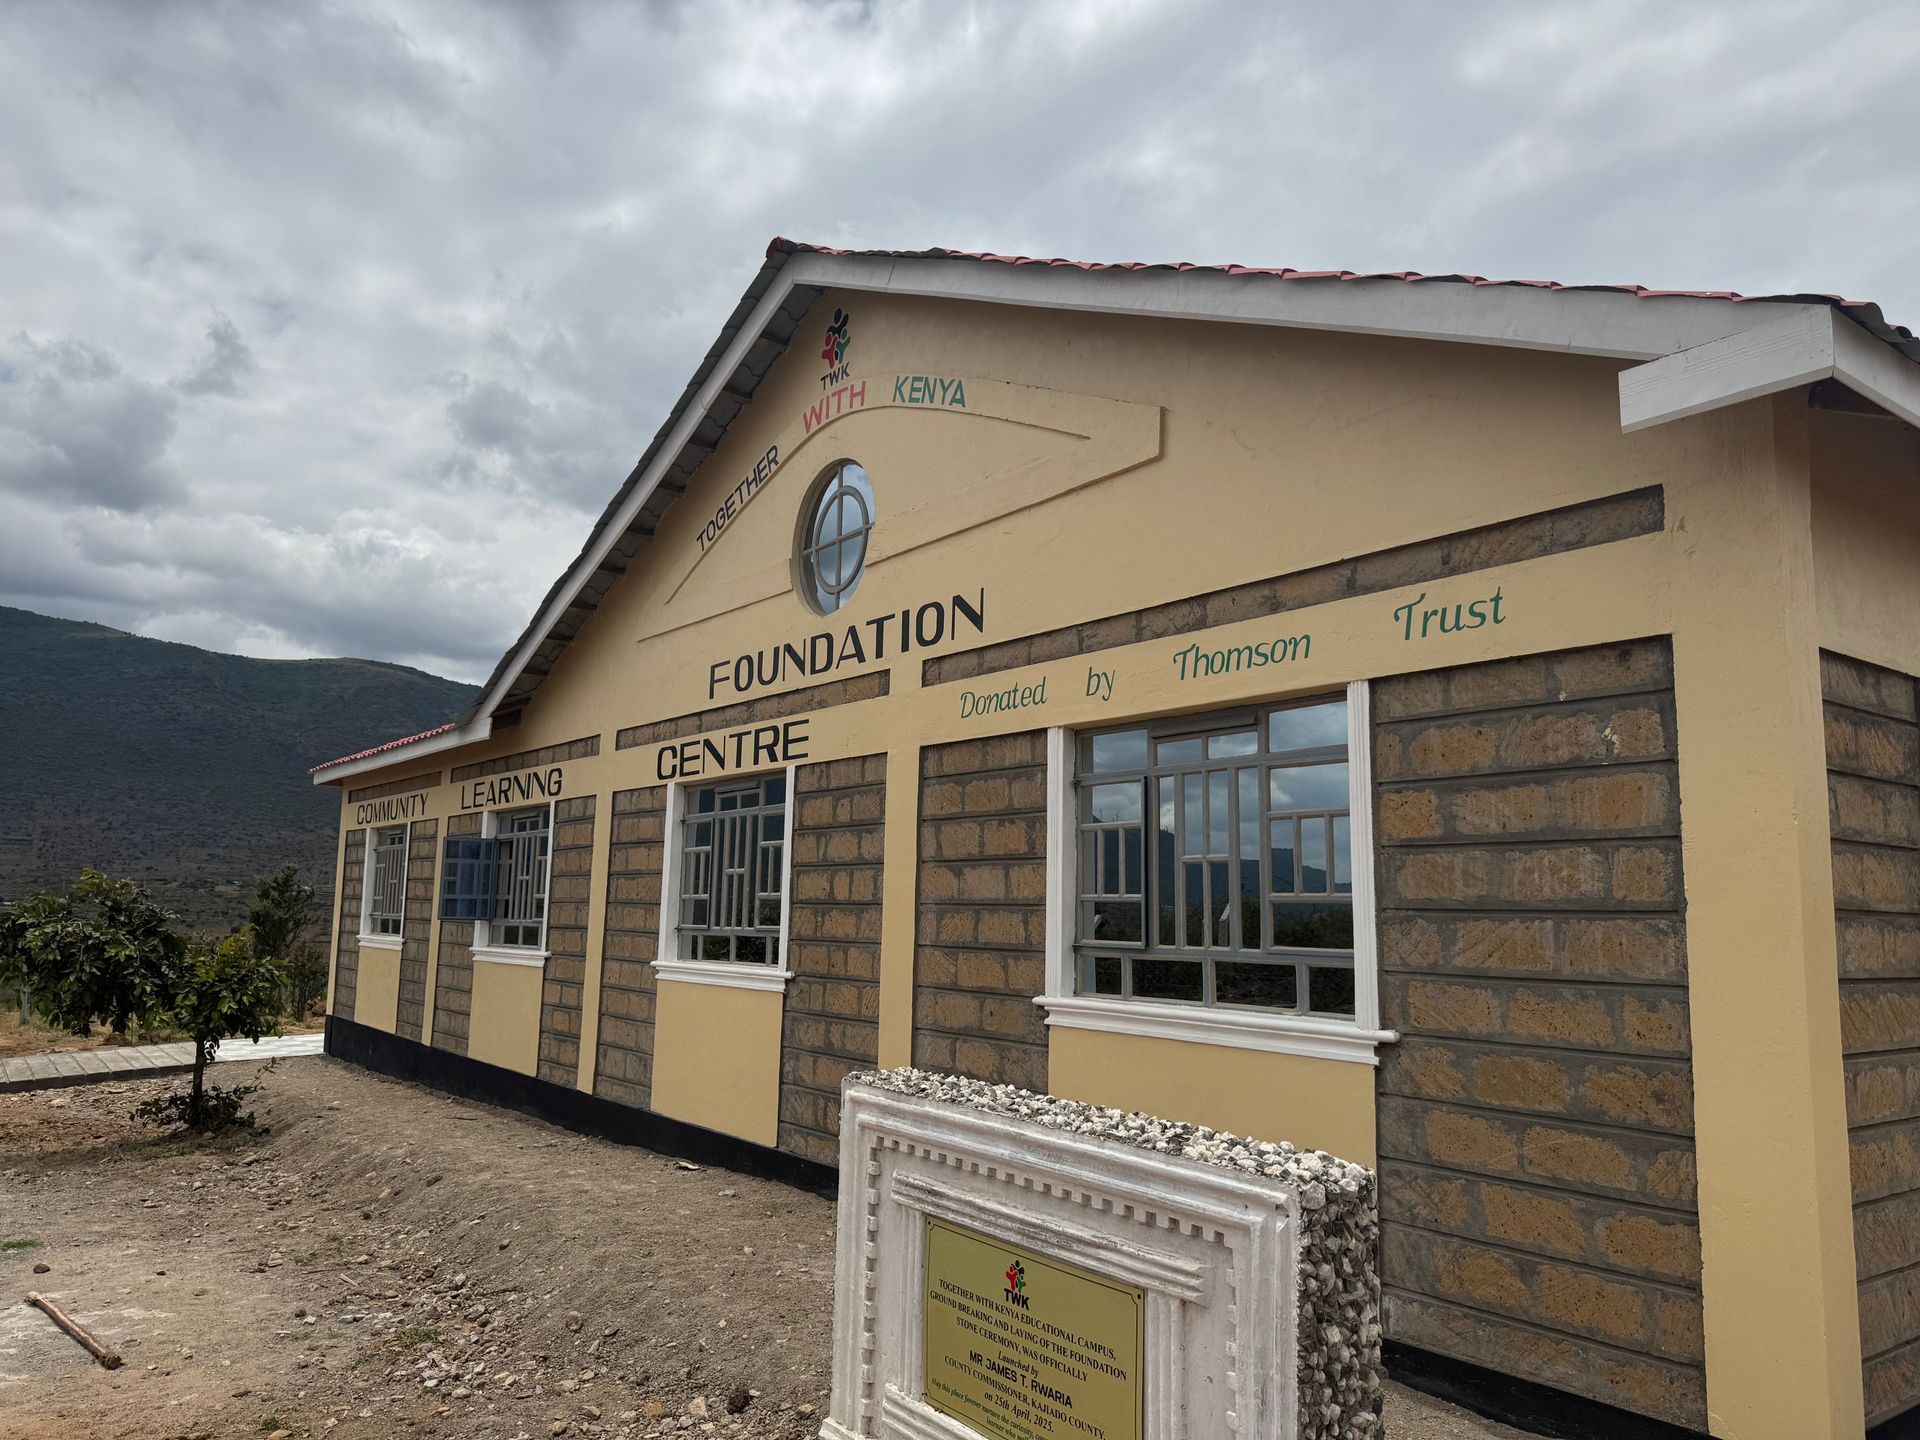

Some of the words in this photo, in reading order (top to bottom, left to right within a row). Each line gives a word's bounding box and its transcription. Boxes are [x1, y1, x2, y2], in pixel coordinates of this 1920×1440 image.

[821, 361, 850, 391] TWK
[696, 444, 779, 552] TOGETHER
[803, 381, 866, 434] WITH
[892, 375, 966, 408] KENYA
[709, 587, 985, 699] FOUNDATION
[960, 677, 1047, 720] Donated
[1086, 667, 1116, 702] by
[1173, 633, 1312, 680] Thomson
[1393, 586, 1506, 641] Trust
[461, 767, 562, 810] LEARNING
[657, 719, 810, 780] CENTRE
[939, 1279, 974, 1301] TOGETHER
[975, 1294, 994, 1311] WITH
[995, 1303, 1020, 1322] KENYA
[1021, 1313, 1077, 1345] EDUCATIONAL
[1003, 1287, 1030, 1311] TWK
[929, 1290, 957, 1310] GROUND
[957, 1301, 993, 1325] BREAKING
[993, 1319, 1009, 1333] AND
[1010, 1326, 1038, 1346] LAYING
[1039, 1338, 1051, 1350] OF
[1050, 1342, 1068, 1357] THE
[1069, 1349, 1127, 1381] FOUNDATION
[956, 1316, 978, 1335] STONE
[1022, 1345, 1039, 1362] WAS
[1039, 1354, 1088, 1382] OFFICIALLY
[997, 1350, 1030, 1373] Launched
[1030, 1364, 1040, 1378] by
[944, 1355, 972, 1376] COUNTY
[1031, 1397, 1067, 1422] KAJIADO
[951, 1388, 964, 1399] place
[969, 1349, 983, 1366] MR
[985, 1357, 1017, 1383] JAMES
[1020, 1374, 1028, 1388] T.
[1031, 1379, 1073, 1409] RWARIA
[984, 1391, 993, 1402] on
[994, 1394, 1010, 1411] 25th
[1011, 1403, 1031, 1421] April,
[1033, 1413, 1054, 1433] 2025.
